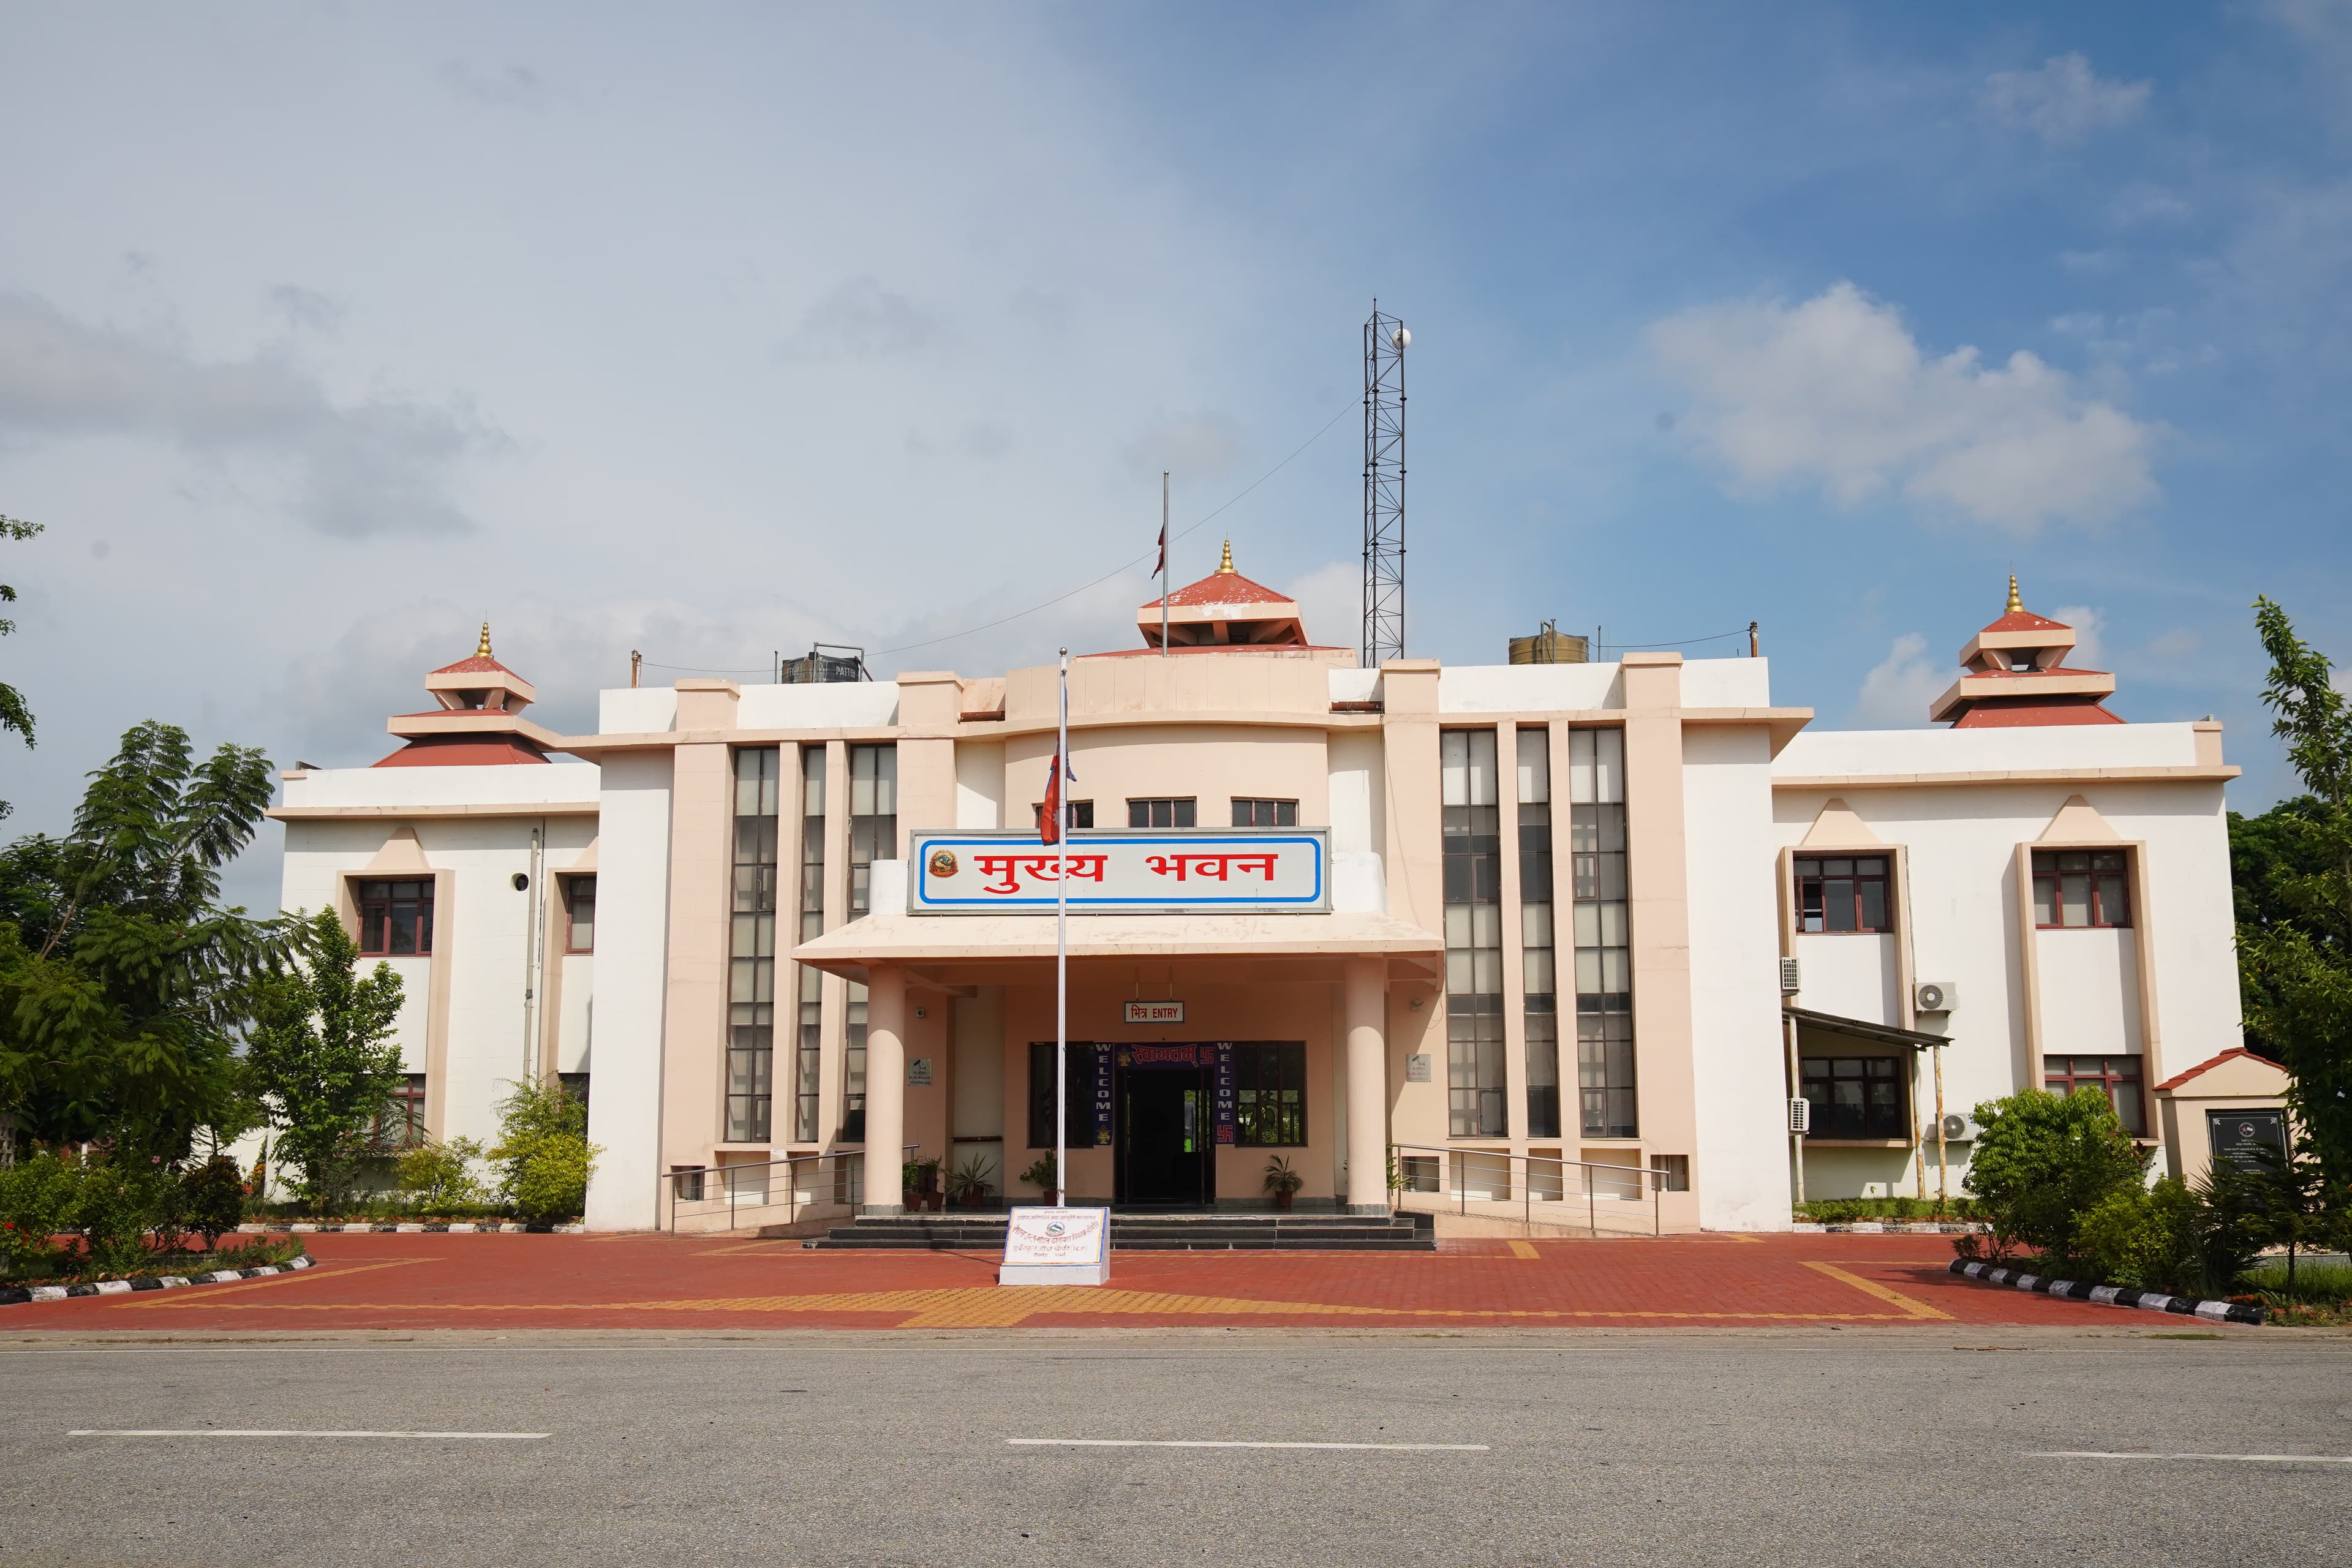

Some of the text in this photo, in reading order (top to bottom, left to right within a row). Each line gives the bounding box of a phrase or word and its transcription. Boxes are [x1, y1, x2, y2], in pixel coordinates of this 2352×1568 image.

[974, 854, 1278, 894] मुख्य भवन
[1131, 1005, 1178, 1019] भित्र ENTRY
[1132, 1044, 1199, 1067] स्वागतम्
[1095, 1044, 1112, 1121] WELCOME
[1217, 1042, 1233, 1120] WELCOME
